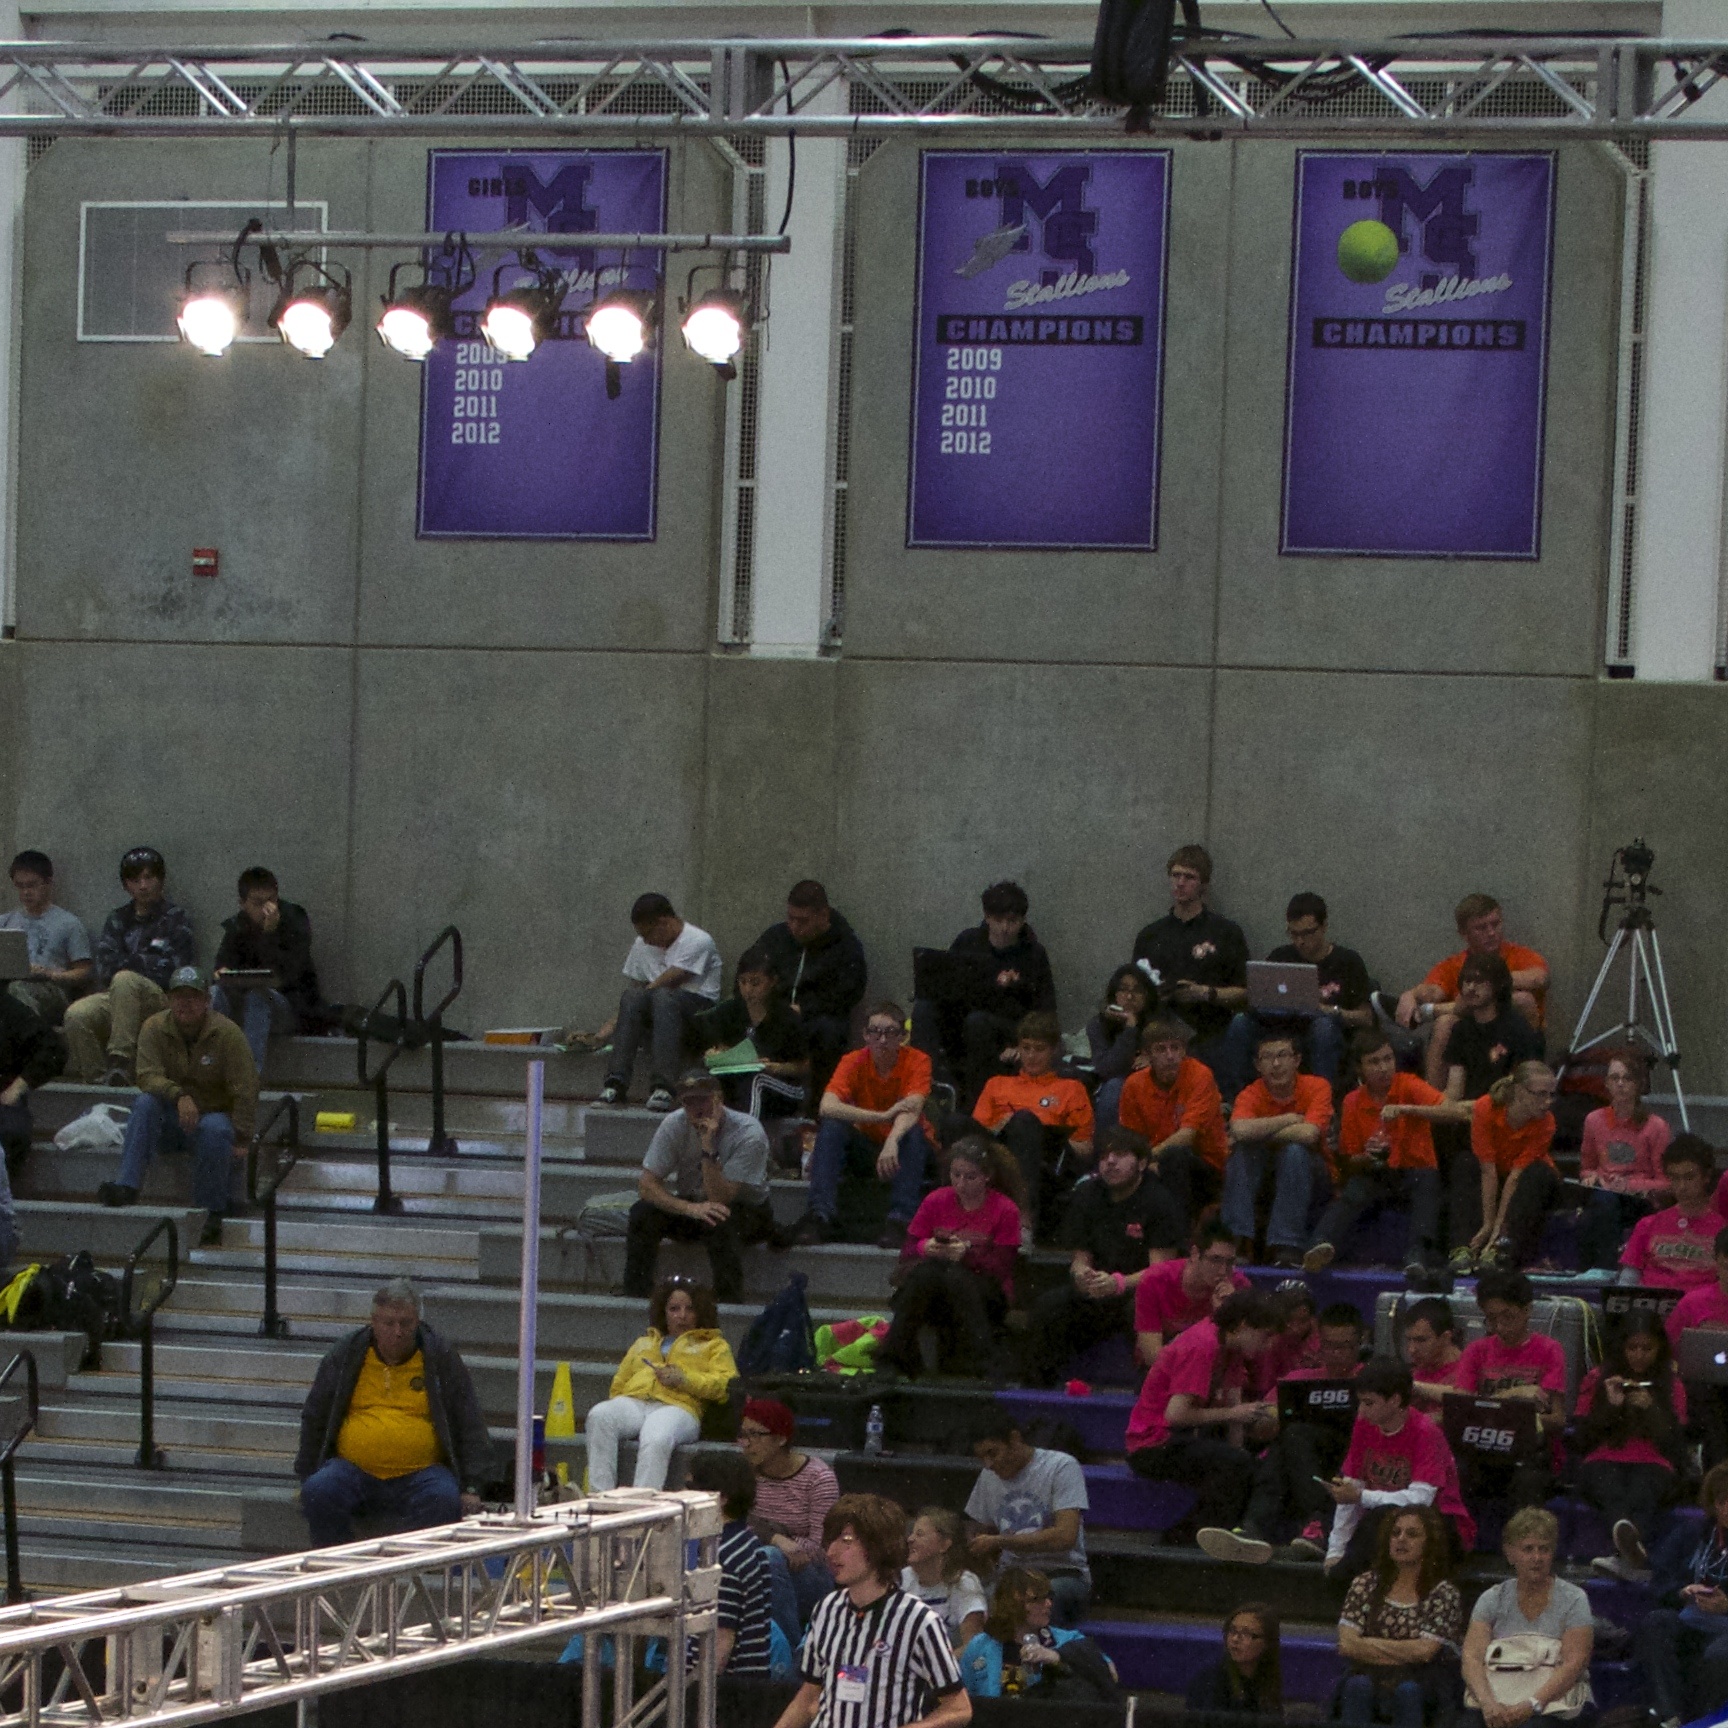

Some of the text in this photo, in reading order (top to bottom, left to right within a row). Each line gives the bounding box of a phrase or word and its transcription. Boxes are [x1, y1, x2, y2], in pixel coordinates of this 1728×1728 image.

[1003, 269, 1130, 311] Stallions
[1382, 272, 1513, 314] Stallions
[946, 320, 1134, 341] CHAMPIONS
[1323, 322, 1518, 346] CHAMPIONS
[947, 349, 1002, 370] 2009
[454, 369, 503, 391] 2010
[945, 376, 996, 399] 2010
[453, 396, 497, 418] 2011
[941, 405, 987, 427] 2011
[451, 422, 500, 444] 2012
[940, 431, 992, 454] 2012
[1308, 1389, 1350, 1405] 696
[1461, 1425, 1516, 1446] 696
